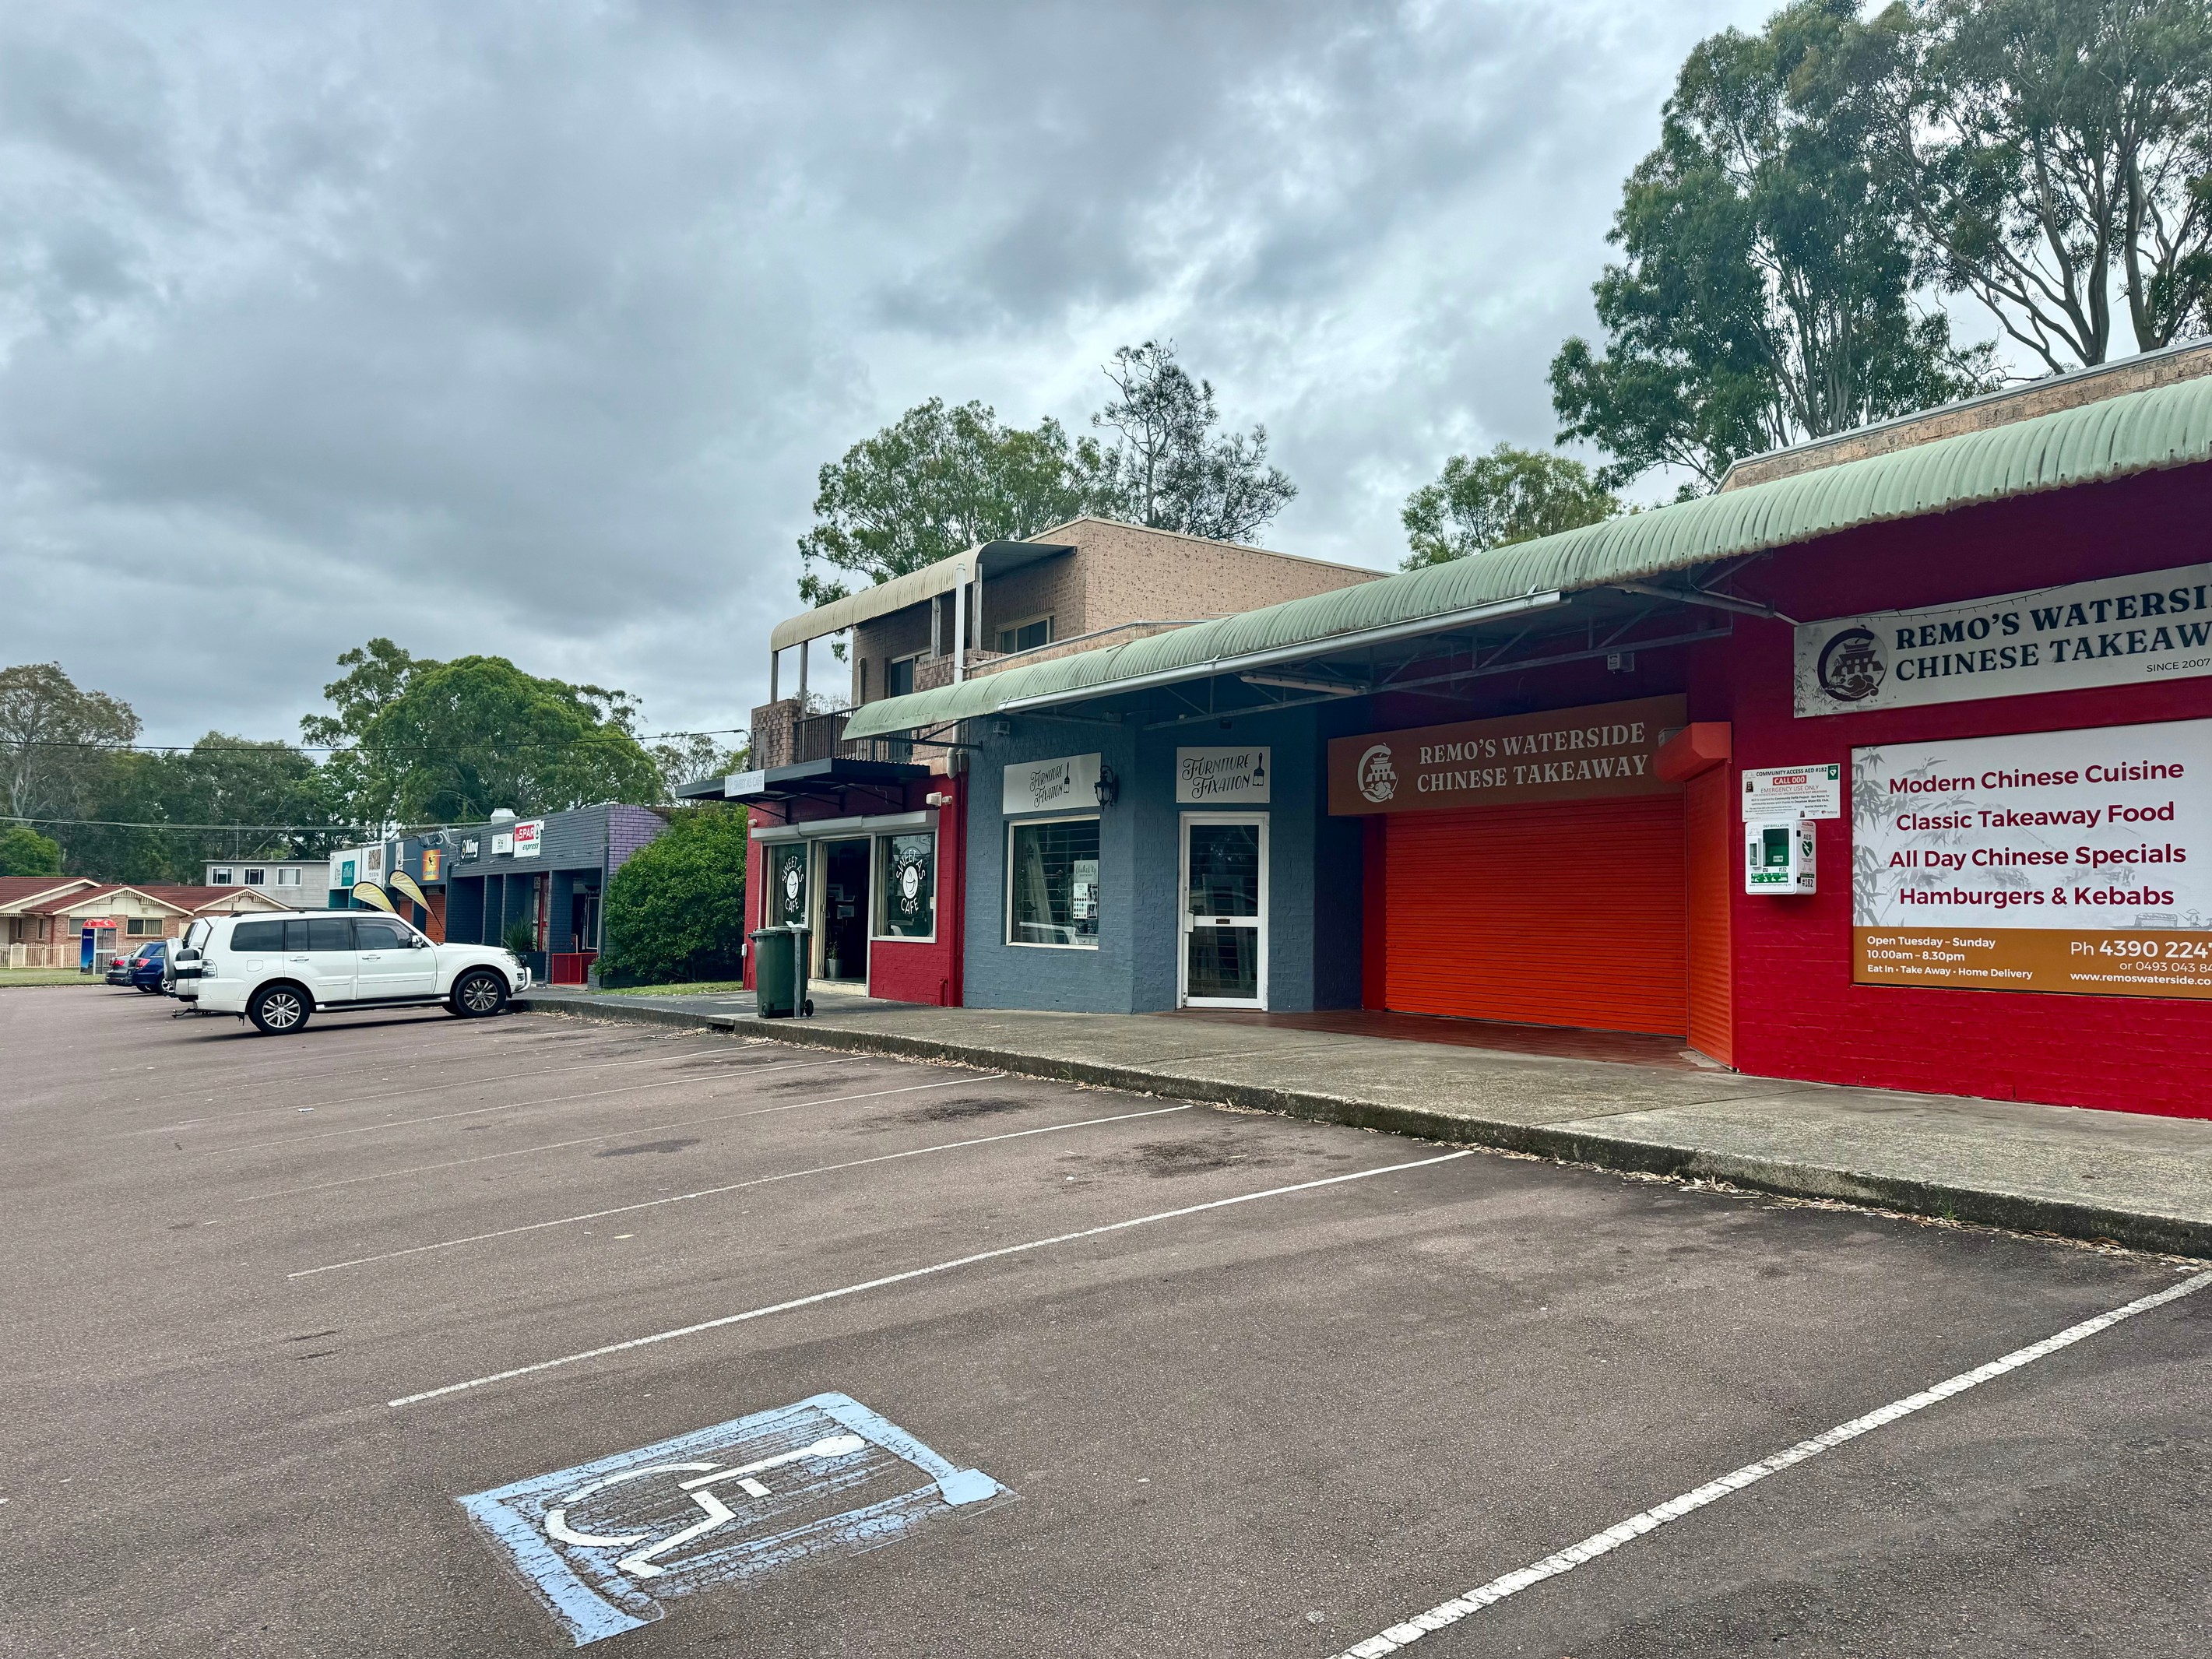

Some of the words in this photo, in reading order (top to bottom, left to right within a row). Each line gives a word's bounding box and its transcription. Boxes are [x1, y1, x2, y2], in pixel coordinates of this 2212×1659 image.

[1895, 612, 2020, 650] REMO’S
[2029, 583, 2212, 631] WATERSI
[1896, 643, 2040, 681] CHINESE
[2147, 661, 2180, 673] SINCE
[2182, 658, 2210, 670] 2007
[1419, 737, 1496, 765] REMO’S
[1501, 722, 1646, 757] WATERSIDE
[1182, 754, 1250, 781] FURNITURE
[1417, 768, 1507, 793] CHINESE
[1513, 754, 1649, 786] TAKEAWAY
[1889, 774, 1975, 795] Modern
[1981, 768, 2079, 789] Chinese
[2085, 760, 2185, 784] Cuisine
[1191, 774, 1250, 799] FIXATION
[1896, 810, 1972, 831] Classic
[1978, 807, 2101, 828] Takeaway
[2108, 801, 2175, 823] Food
[519, 827, 534, 839] SPAR
[466, 838, 479, 858] King
[522, 842, 540, 852] express
[1889, 849, 1918, 868] All
[1925, 850, 1966, 871] Day
[1971, 847, 2069, 866] Chinese
[2075, 843, 2186, 868] Specials
[782, 856, 798, 884] SWEET
[797, 864, 804, 883] AS
[896, 849, 917, 880] SWEET
[916, 859, 926, 880] AS
[1802, 878, 1813, 887] #182
[785, 897, 800, 913] CAFE
[900, 897, 920, 915] CAFE
[1900, 887, 2045, 909] Hamburgers
[2051, 887, 2067, 905] &
[2074, 885, 2175, 905] Kebabs
[1867, 936, 1896, 946] Open
[1897, 937, 1943, 948] Tuesday
[1952, 937, 1996, 949] Sunday
[2070, 941, 2094, 956] Ph
[2099, 940, 2158, 957] 4390
[1866, 950, 1913, 959] 10.00am
[1922, 951, 1965, 962] 8.30pm
[2136, 961, 2168, 972] 0493
[2171, 962, 2196, 972] 043
[1884, 965, 1894, 973] In
[1901, 965, 1922, 974] Take
[1925, 967, 1950, 976] Away
[1958, 968, 1988, 976] Home
[1991, 968, 2033, 979] Delivery
